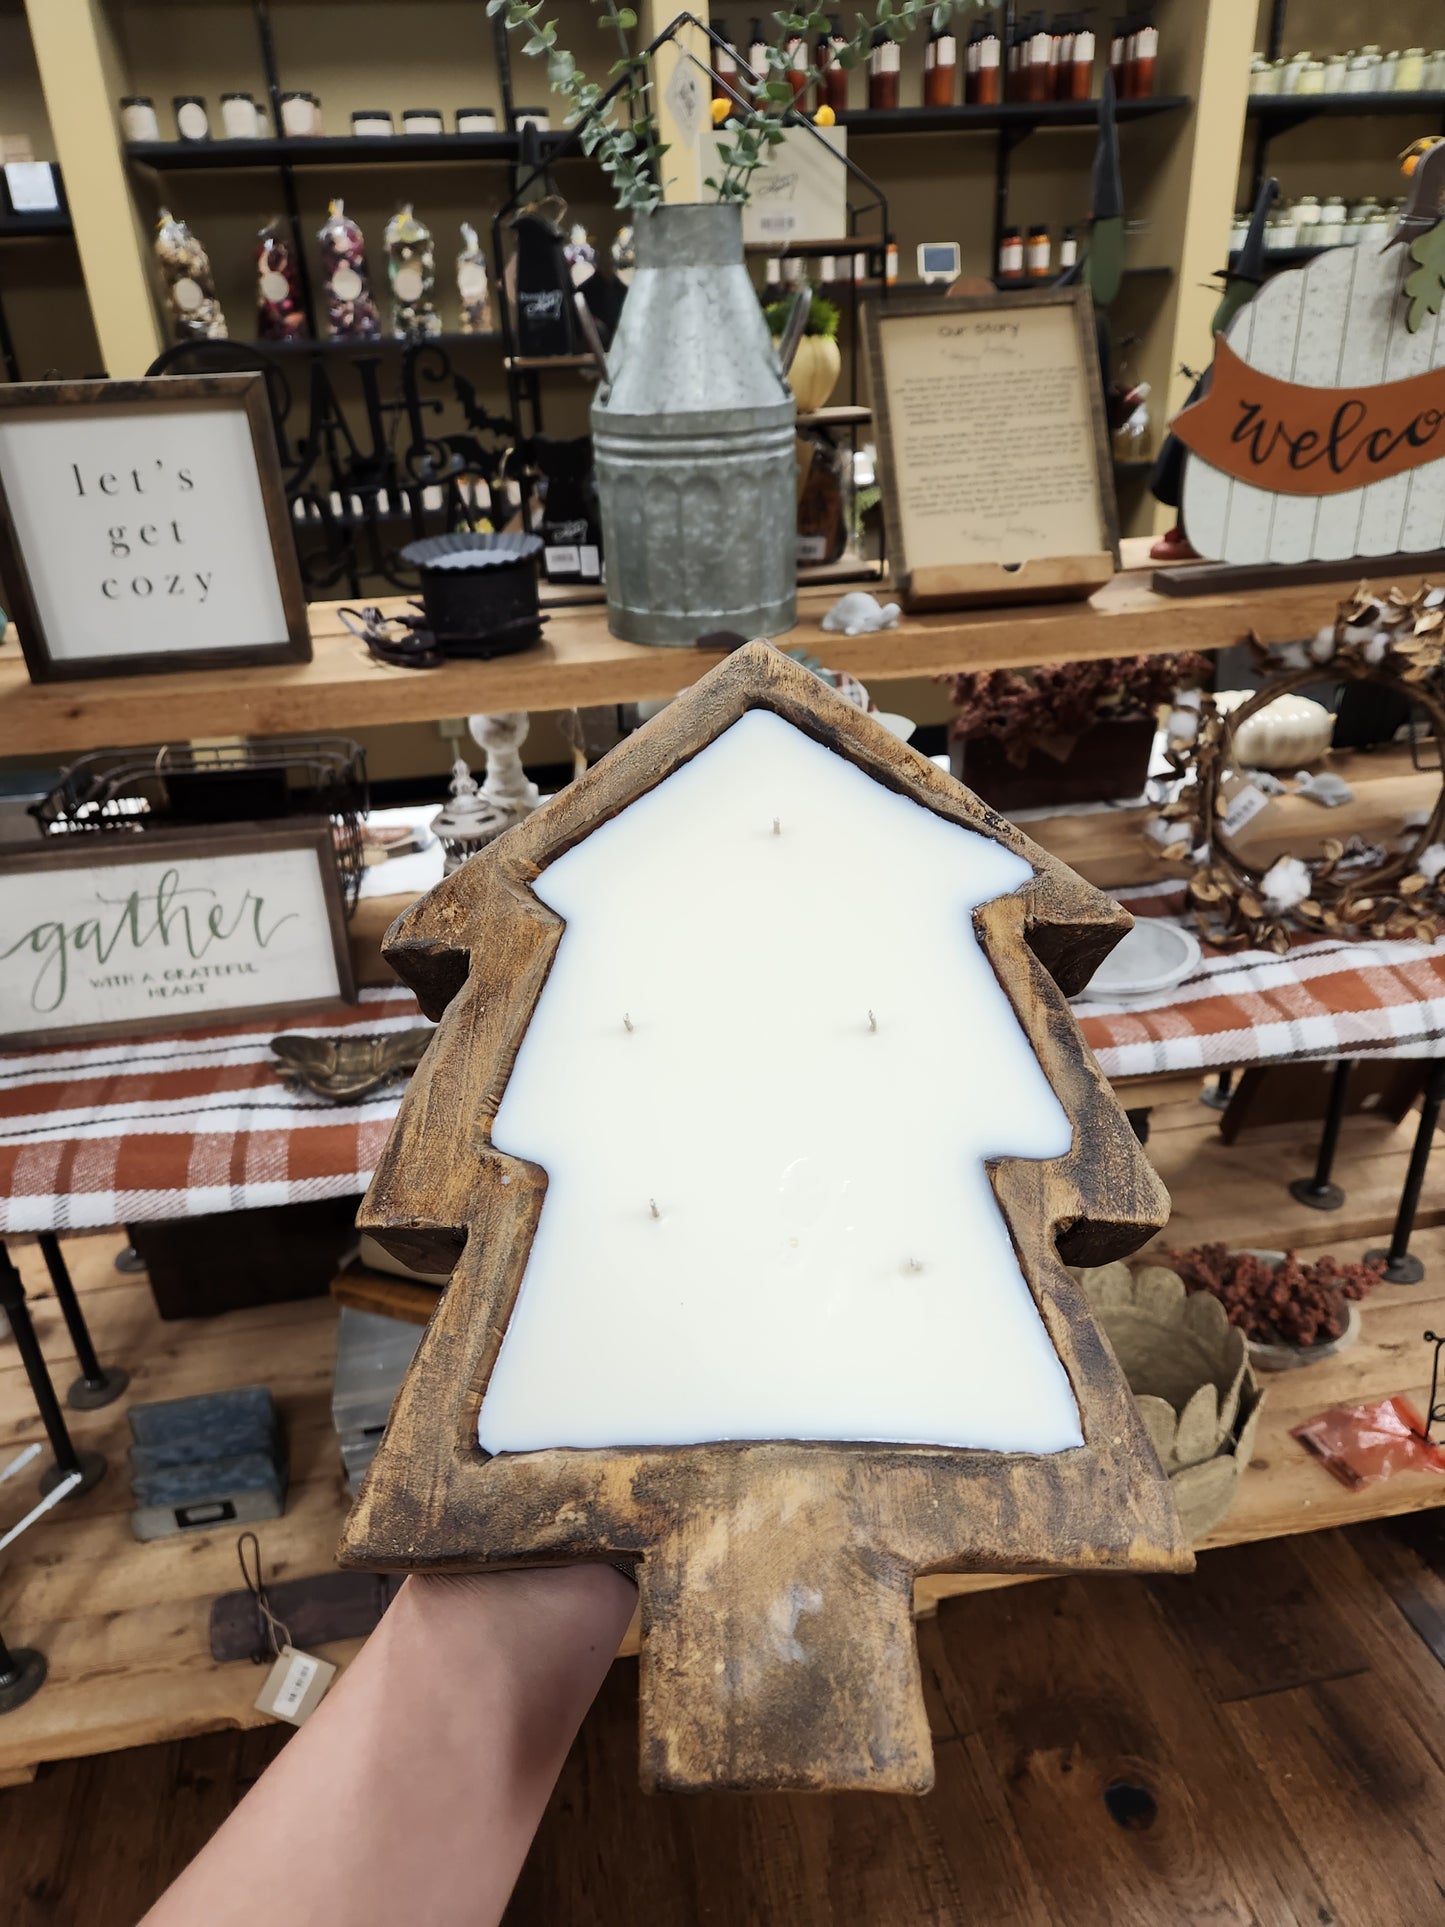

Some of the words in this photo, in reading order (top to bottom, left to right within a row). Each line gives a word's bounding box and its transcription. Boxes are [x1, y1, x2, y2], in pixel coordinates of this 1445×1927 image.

[938, 325, 968, 338] Our
[974, 321, 1021, 338] Story
[72, 458, 194, 497] let's
[107, 519, 186, 558] get
[101, 571, 213, 603] cozy
[0, 868, 299, 1014] gather
[89, 971, 135, 989] WITH
[142, 970, 156, 983] A
[163, 961, 259, 983] GRATEFUL
[148, 982, 208, 999] HEART
